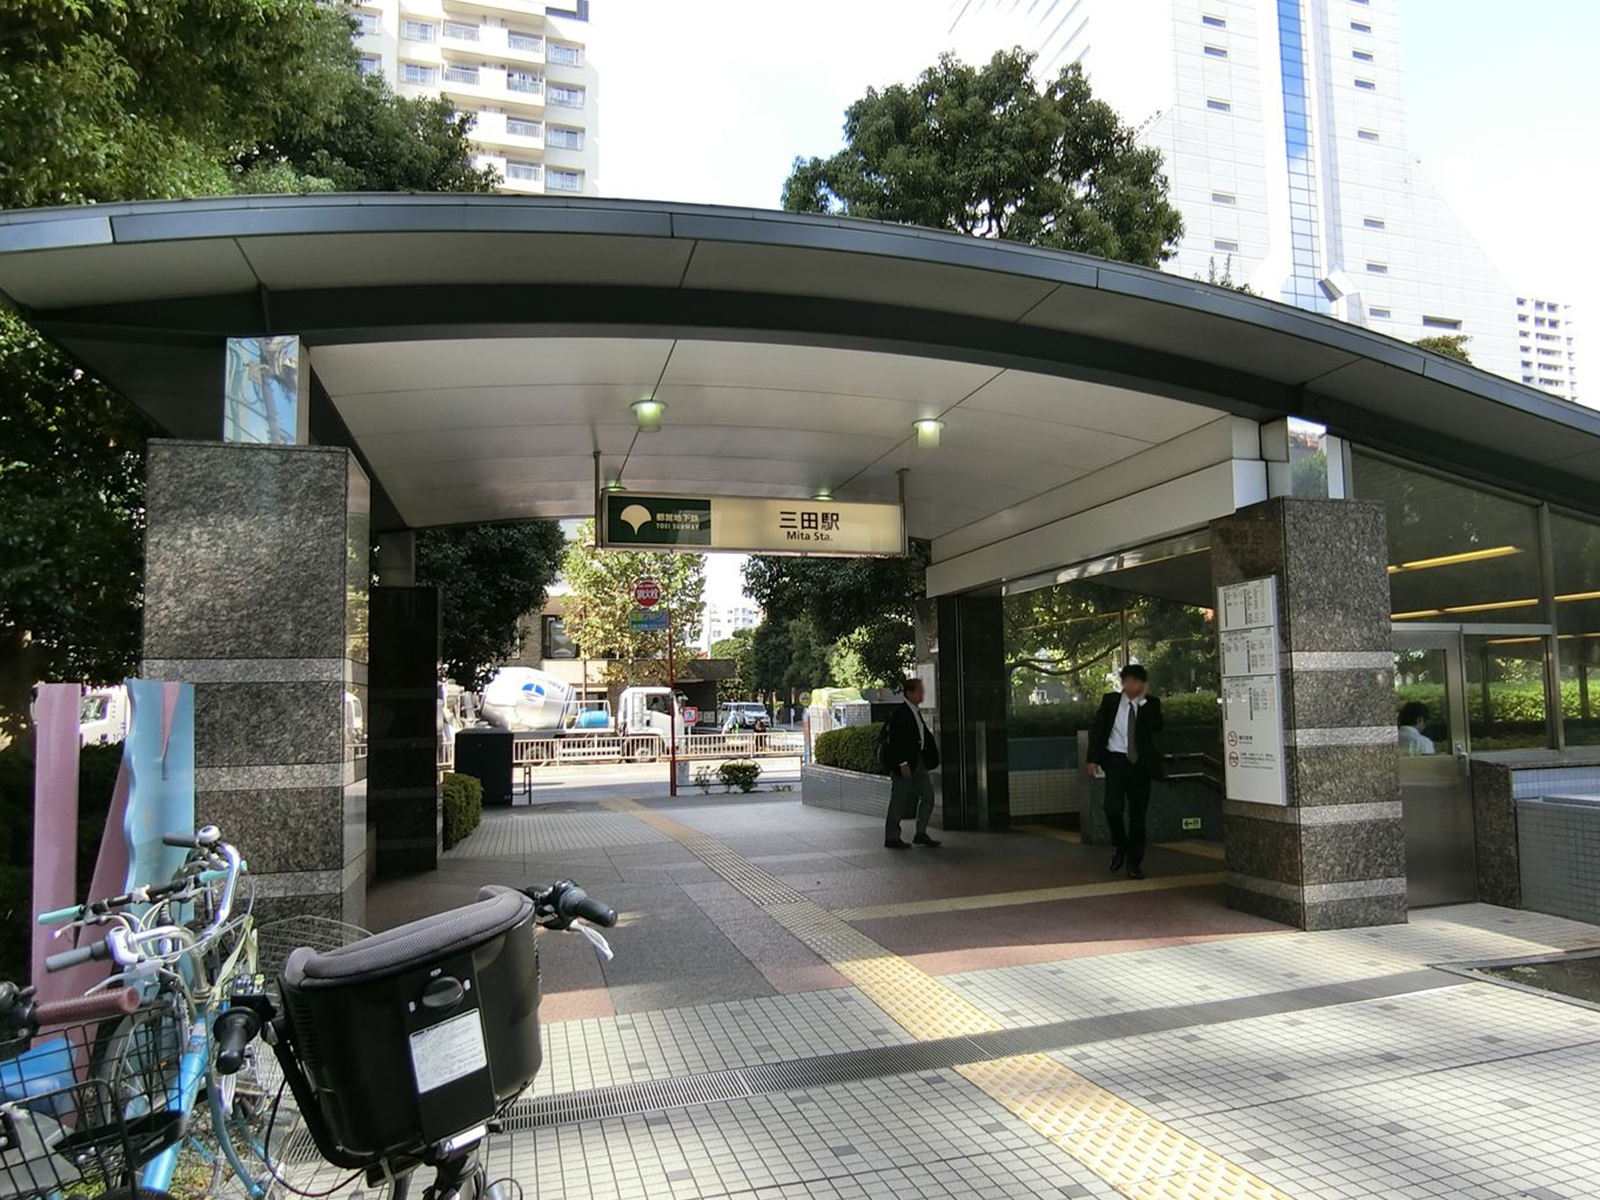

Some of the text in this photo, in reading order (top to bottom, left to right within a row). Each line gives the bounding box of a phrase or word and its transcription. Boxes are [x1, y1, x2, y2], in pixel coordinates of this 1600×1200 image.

[779, 511, 840, 531] 三田駅
[787, 531, 834, 541] Mita Sta.
